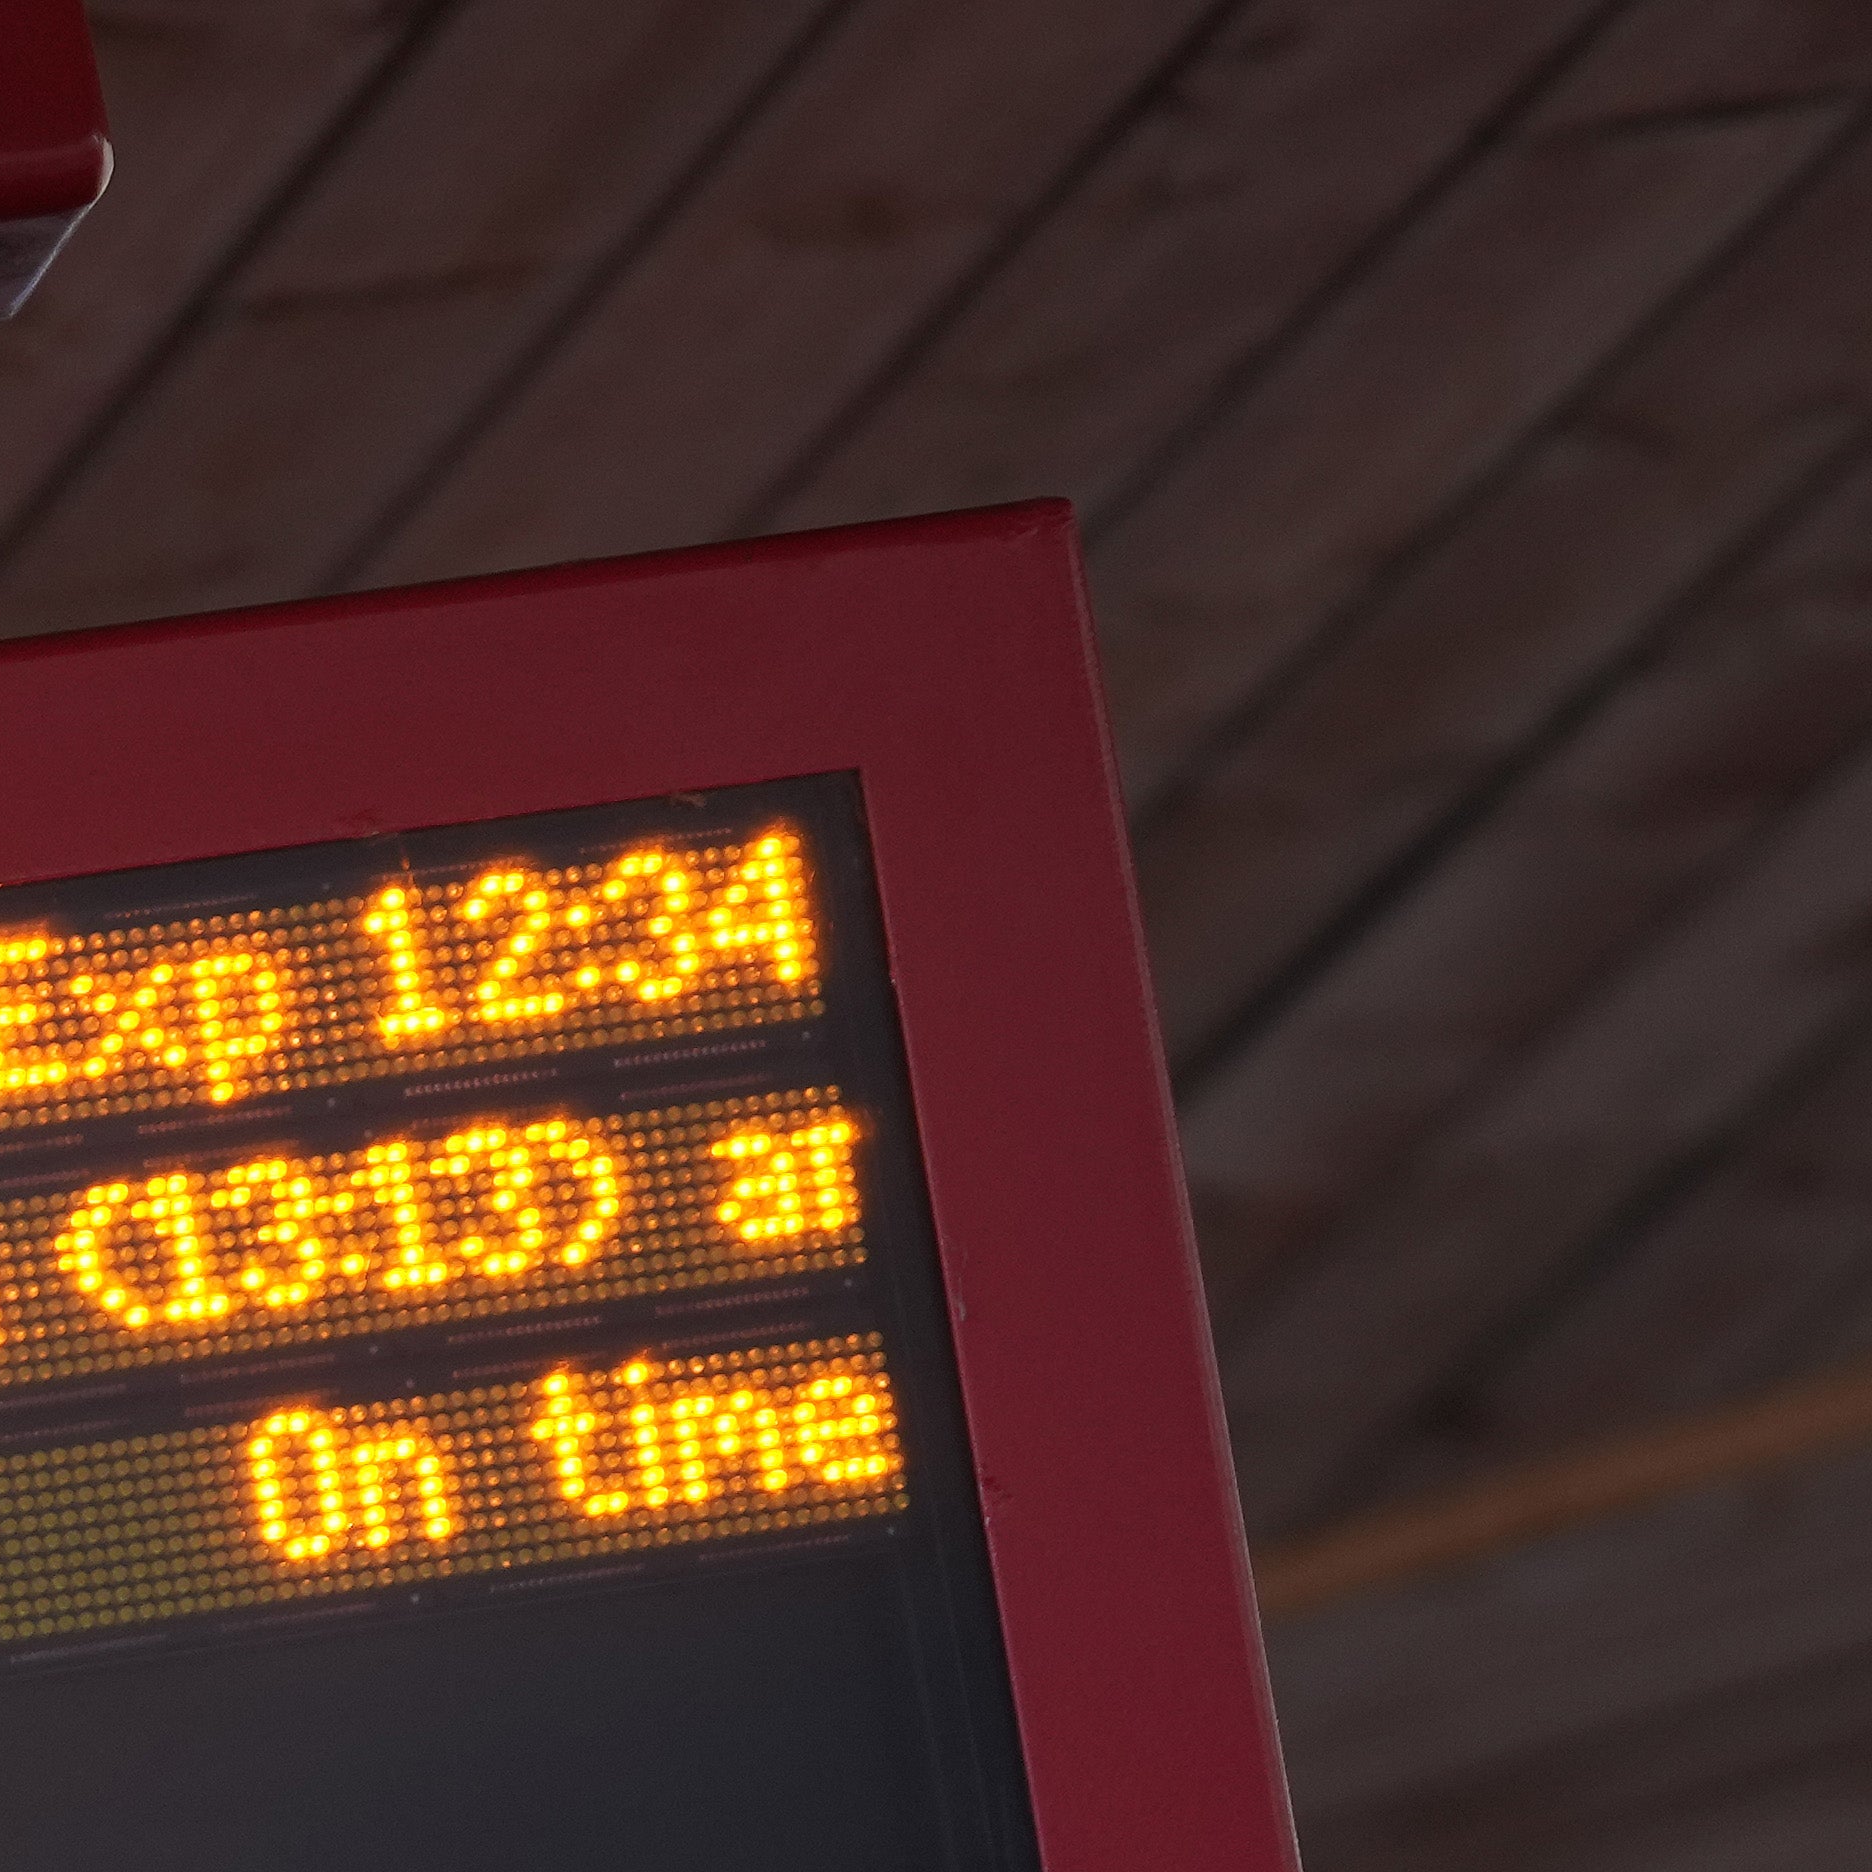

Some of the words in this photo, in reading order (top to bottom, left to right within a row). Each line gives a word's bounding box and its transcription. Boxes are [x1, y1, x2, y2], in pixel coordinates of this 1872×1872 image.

[364, 830, 807, 1045] 12:34
[55, 1121, 619, 1327] (13:13)
[244, 1408, 453, 1559] On
[531, 1363, 890, 1515] time
